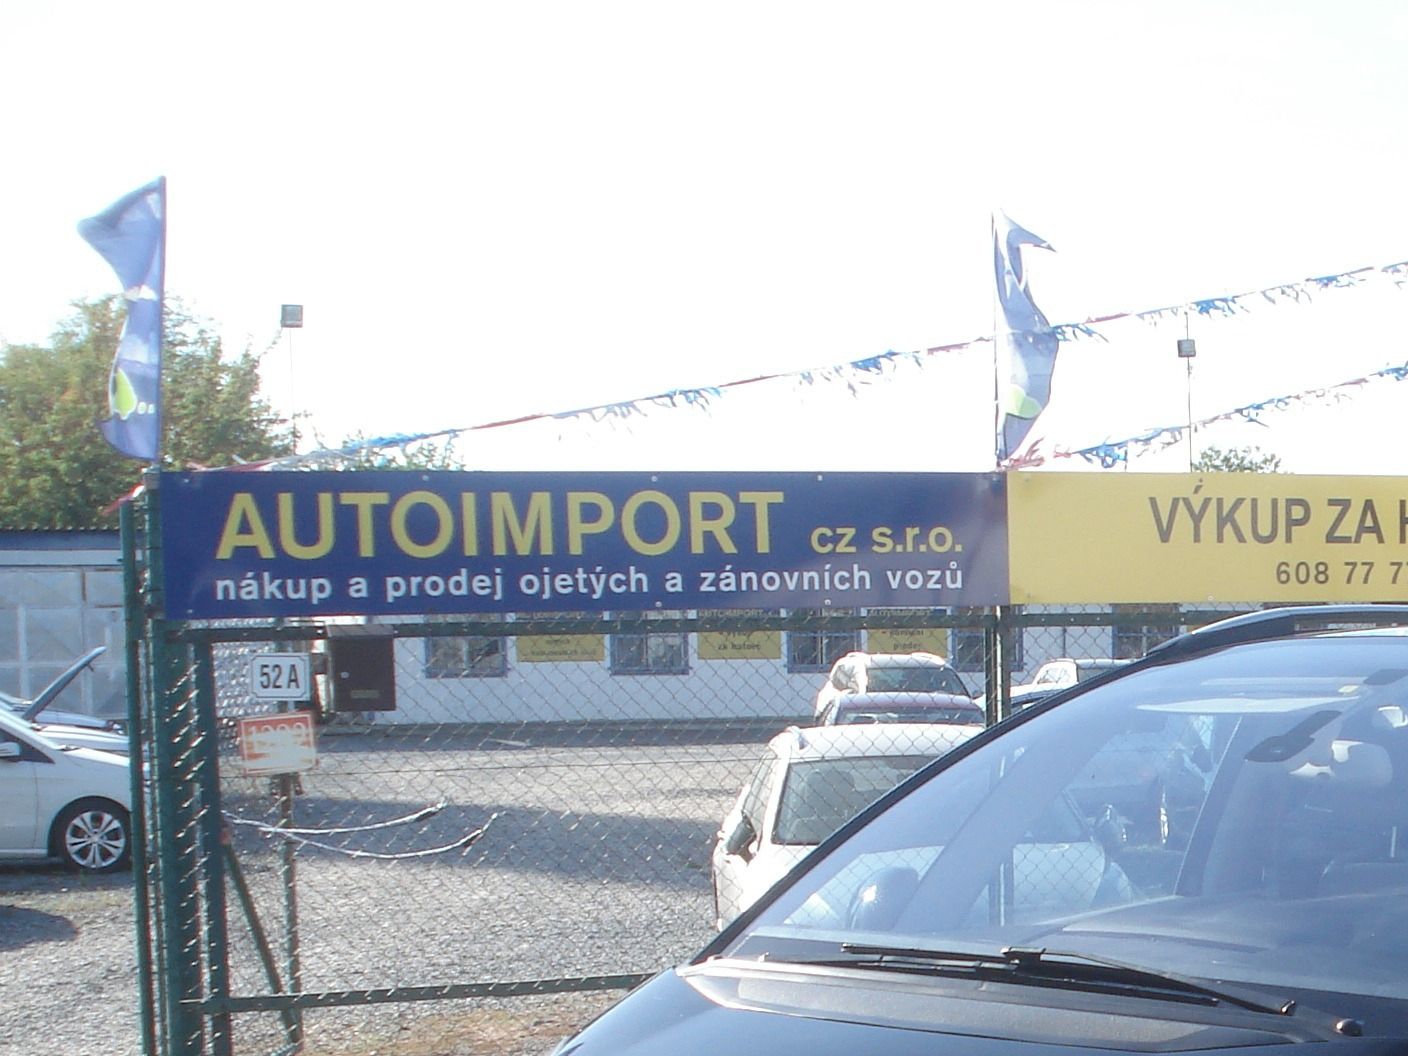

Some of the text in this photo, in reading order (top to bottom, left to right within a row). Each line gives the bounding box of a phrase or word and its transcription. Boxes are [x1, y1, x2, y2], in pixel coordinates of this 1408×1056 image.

[216, 491, 963, 559] AUTOIMPORT cz s.r.o.
[1149, 484, 1311, 545] VÝKUP
[1326, 499, 1384, 545] ZA
[215, 560, 964, 606] nákup a prodej ojetých a zánovních vozů
[1275, 561, 1330, 586] 608
[1343, 561, 1375, 585] 77
[259, 663, 300, 690] 52 A
